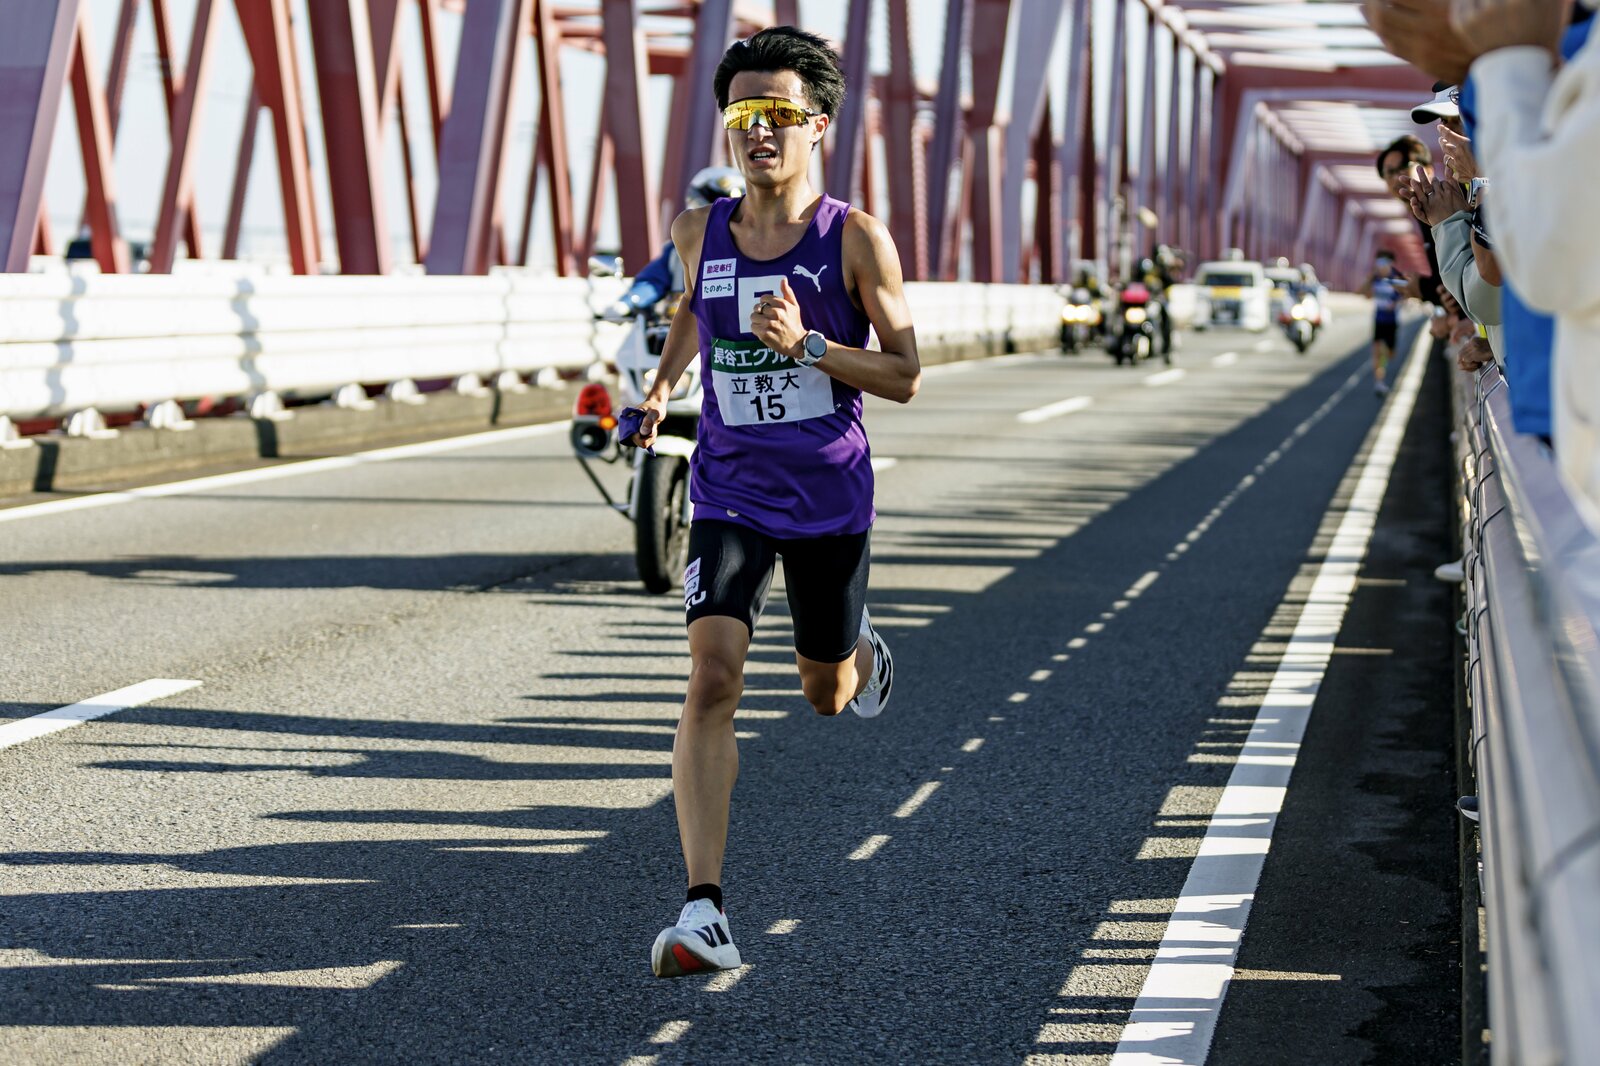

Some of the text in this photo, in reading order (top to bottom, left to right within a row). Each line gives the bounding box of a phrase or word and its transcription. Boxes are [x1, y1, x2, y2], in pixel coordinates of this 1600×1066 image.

[703, 282, 733, 294] たのめーる
[730, 371, 801, 395] 立教大
[749, 393, 786, 422] 15
